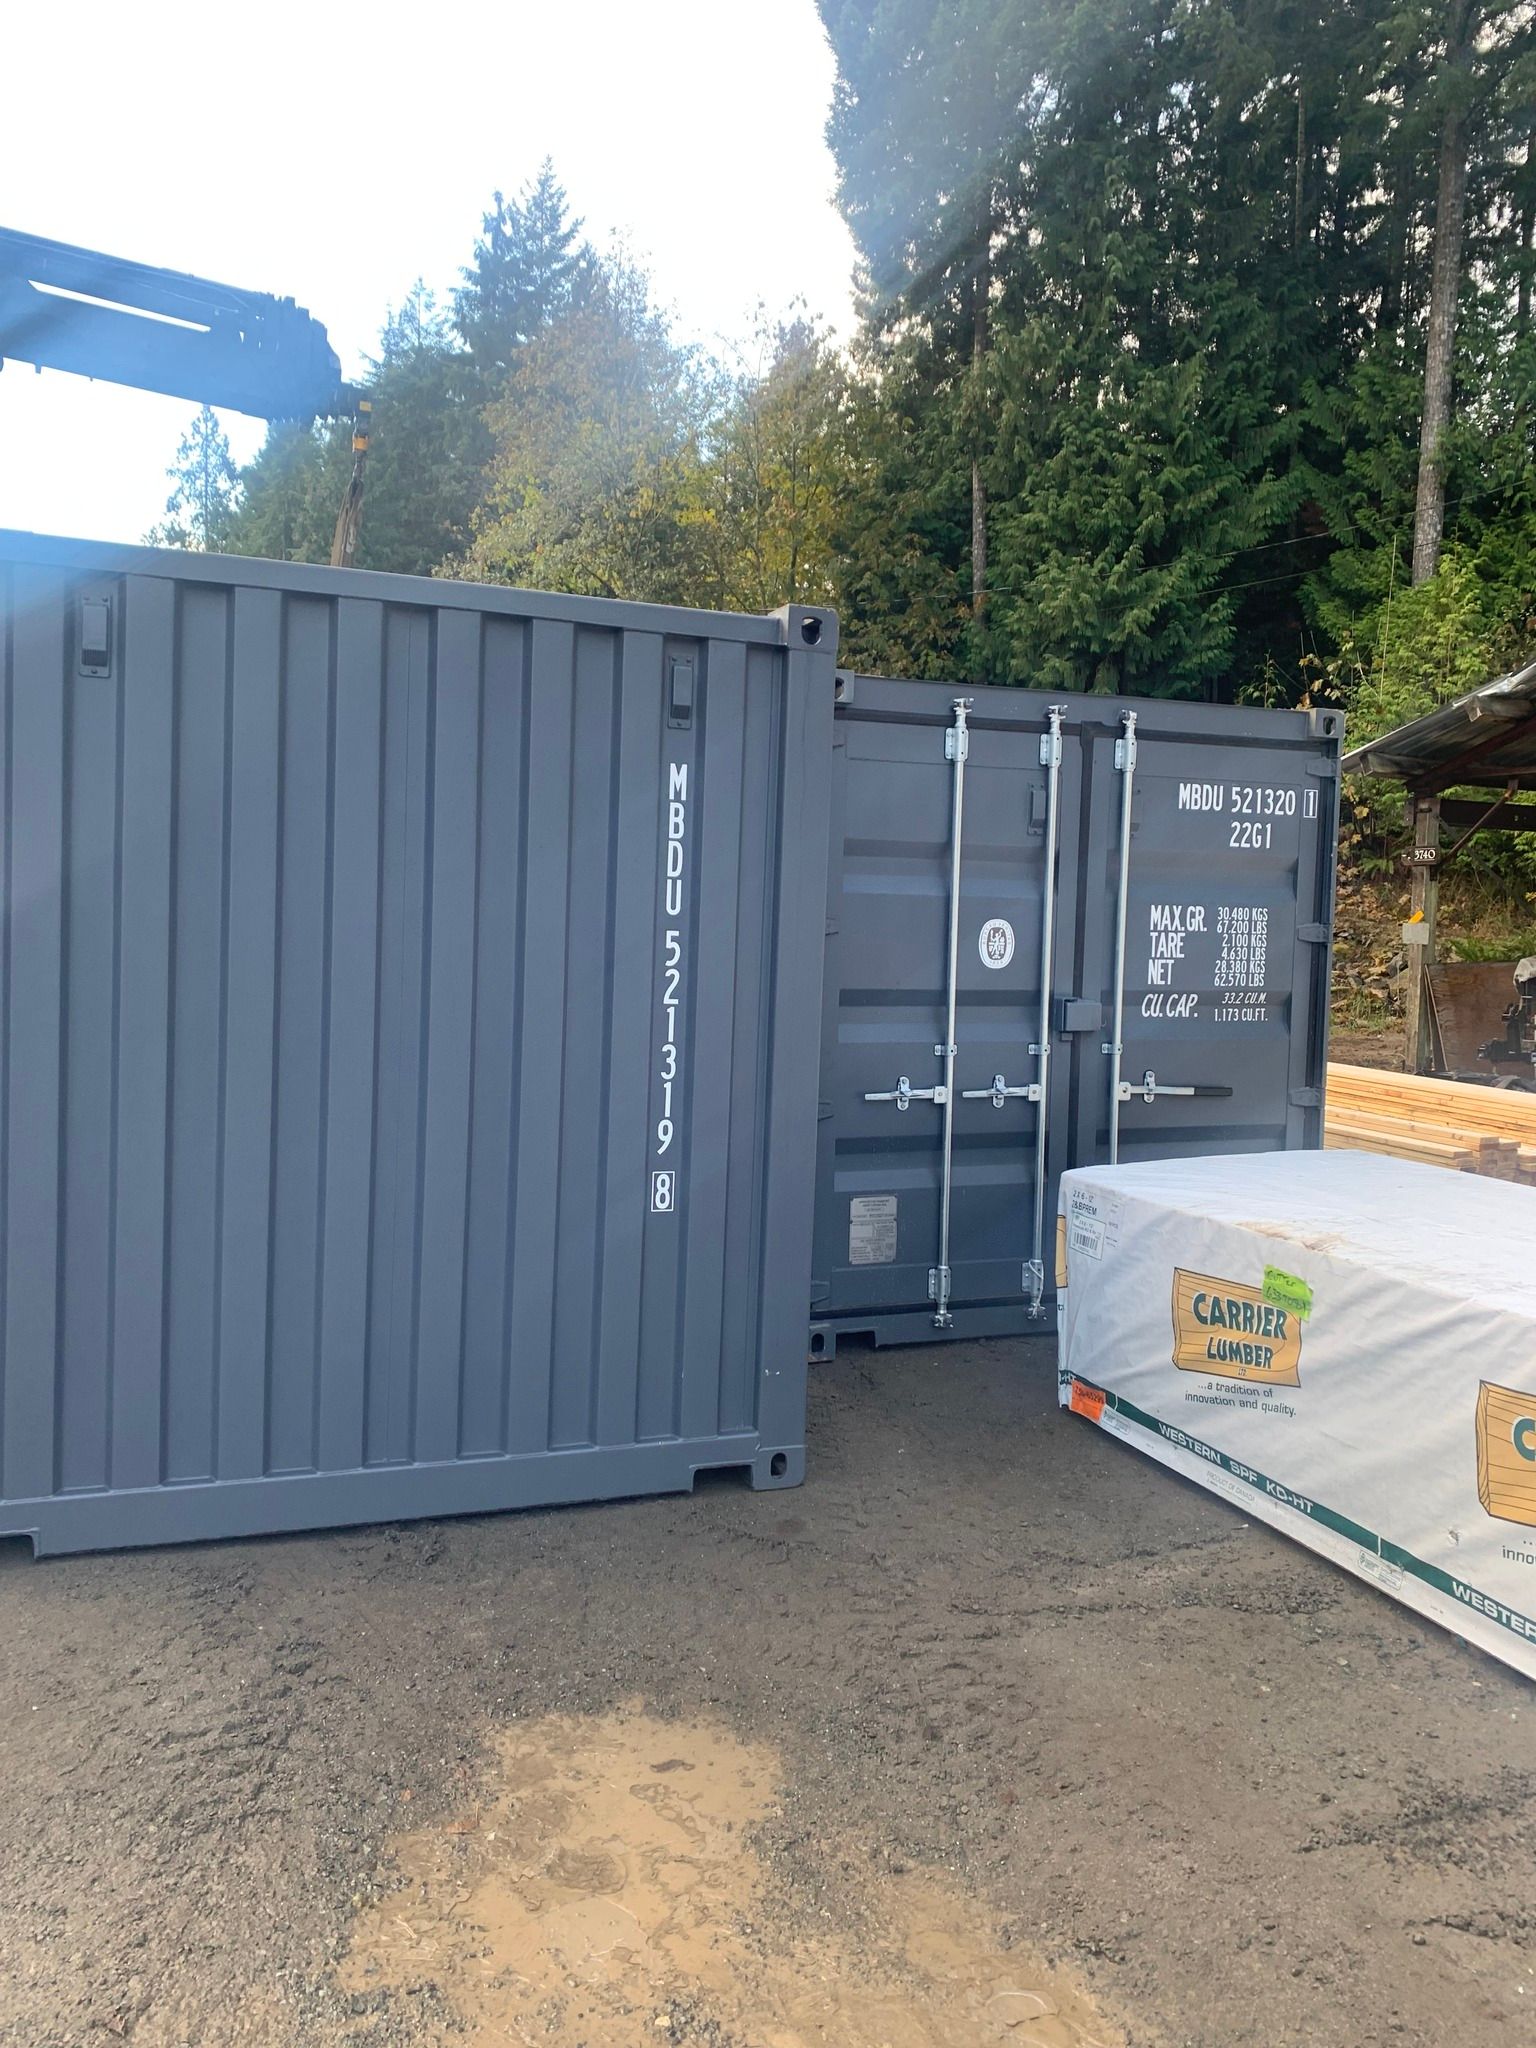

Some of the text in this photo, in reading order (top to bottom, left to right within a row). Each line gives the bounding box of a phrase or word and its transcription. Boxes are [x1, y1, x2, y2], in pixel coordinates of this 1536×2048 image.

[1178, 783, 1224, 811] MBDU
[1231, 787, 1296, 816] 521320
[1229, 821, 1272, 849] 22G1
[1414, 850, 1436, 860] 3740
[1251, 921, 1267, 934] LBS
[1252, 908, 1268, 921] KGS
[1149, 932, 1186, 958] TARE
[1250, 935, 1267, 947] KGS
[1250, 948, 1266, 960] LBS
[1147, 959, 1175, 985] NET
[1249, 961, 1266, 973] KGS
[653, 762, 688, 1210] MBDU 521319 8
[1248, 974, 1265, 987] LBS
[1221, 992, 1244, 1004] 33.2
[1193, 1292, 1288, 1340] CARRIER
[1207, 1337, 1274, 1369] LUMBER
[1216, 1382, 1260, 1397] tradition
[1263, 1388, 1273, 1398] of
[1185, 1390, 1297, 1418] innovation and quality.
[1159, 1422, 1222, 1464] WESTERN
[1230, 1460, 1258, 1482] SPF
[1266, 1479, 1314, 1514] KD-HT
[1452, 1581, 1536, 1640] WESTER
